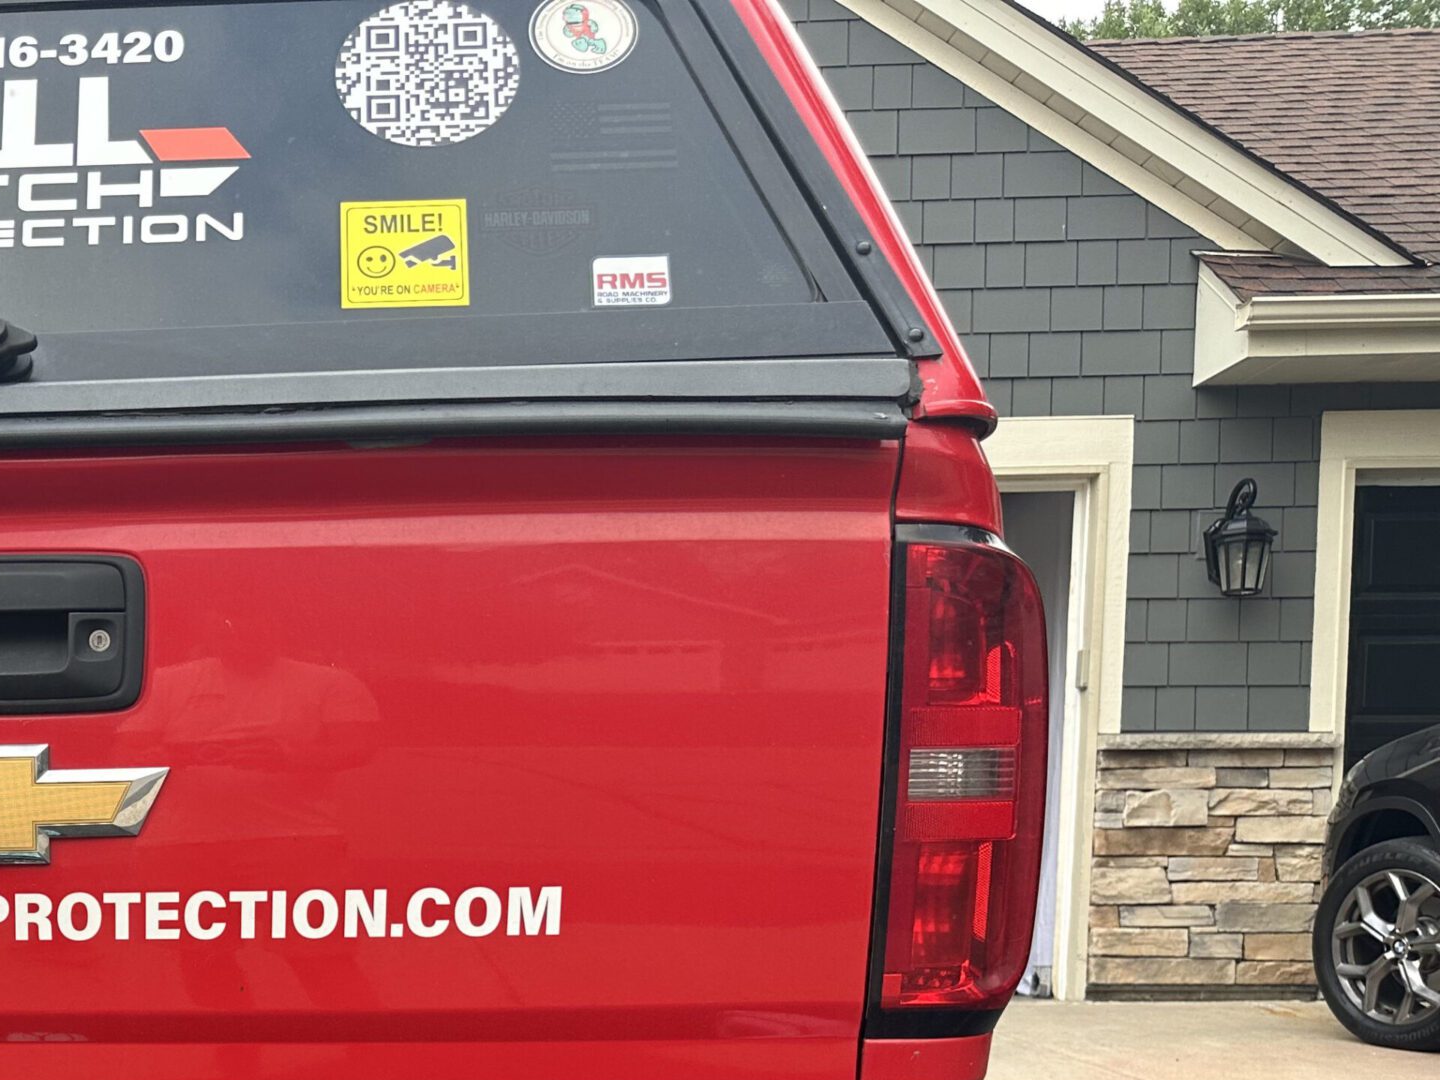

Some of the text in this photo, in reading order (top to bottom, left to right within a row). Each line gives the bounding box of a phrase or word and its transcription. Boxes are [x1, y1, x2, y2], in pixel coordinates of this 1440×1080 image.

[363, 213, 443, 234] SMILE!
[597, 272, 667, 289] RMS
[396, 285, 411, 294] ON
